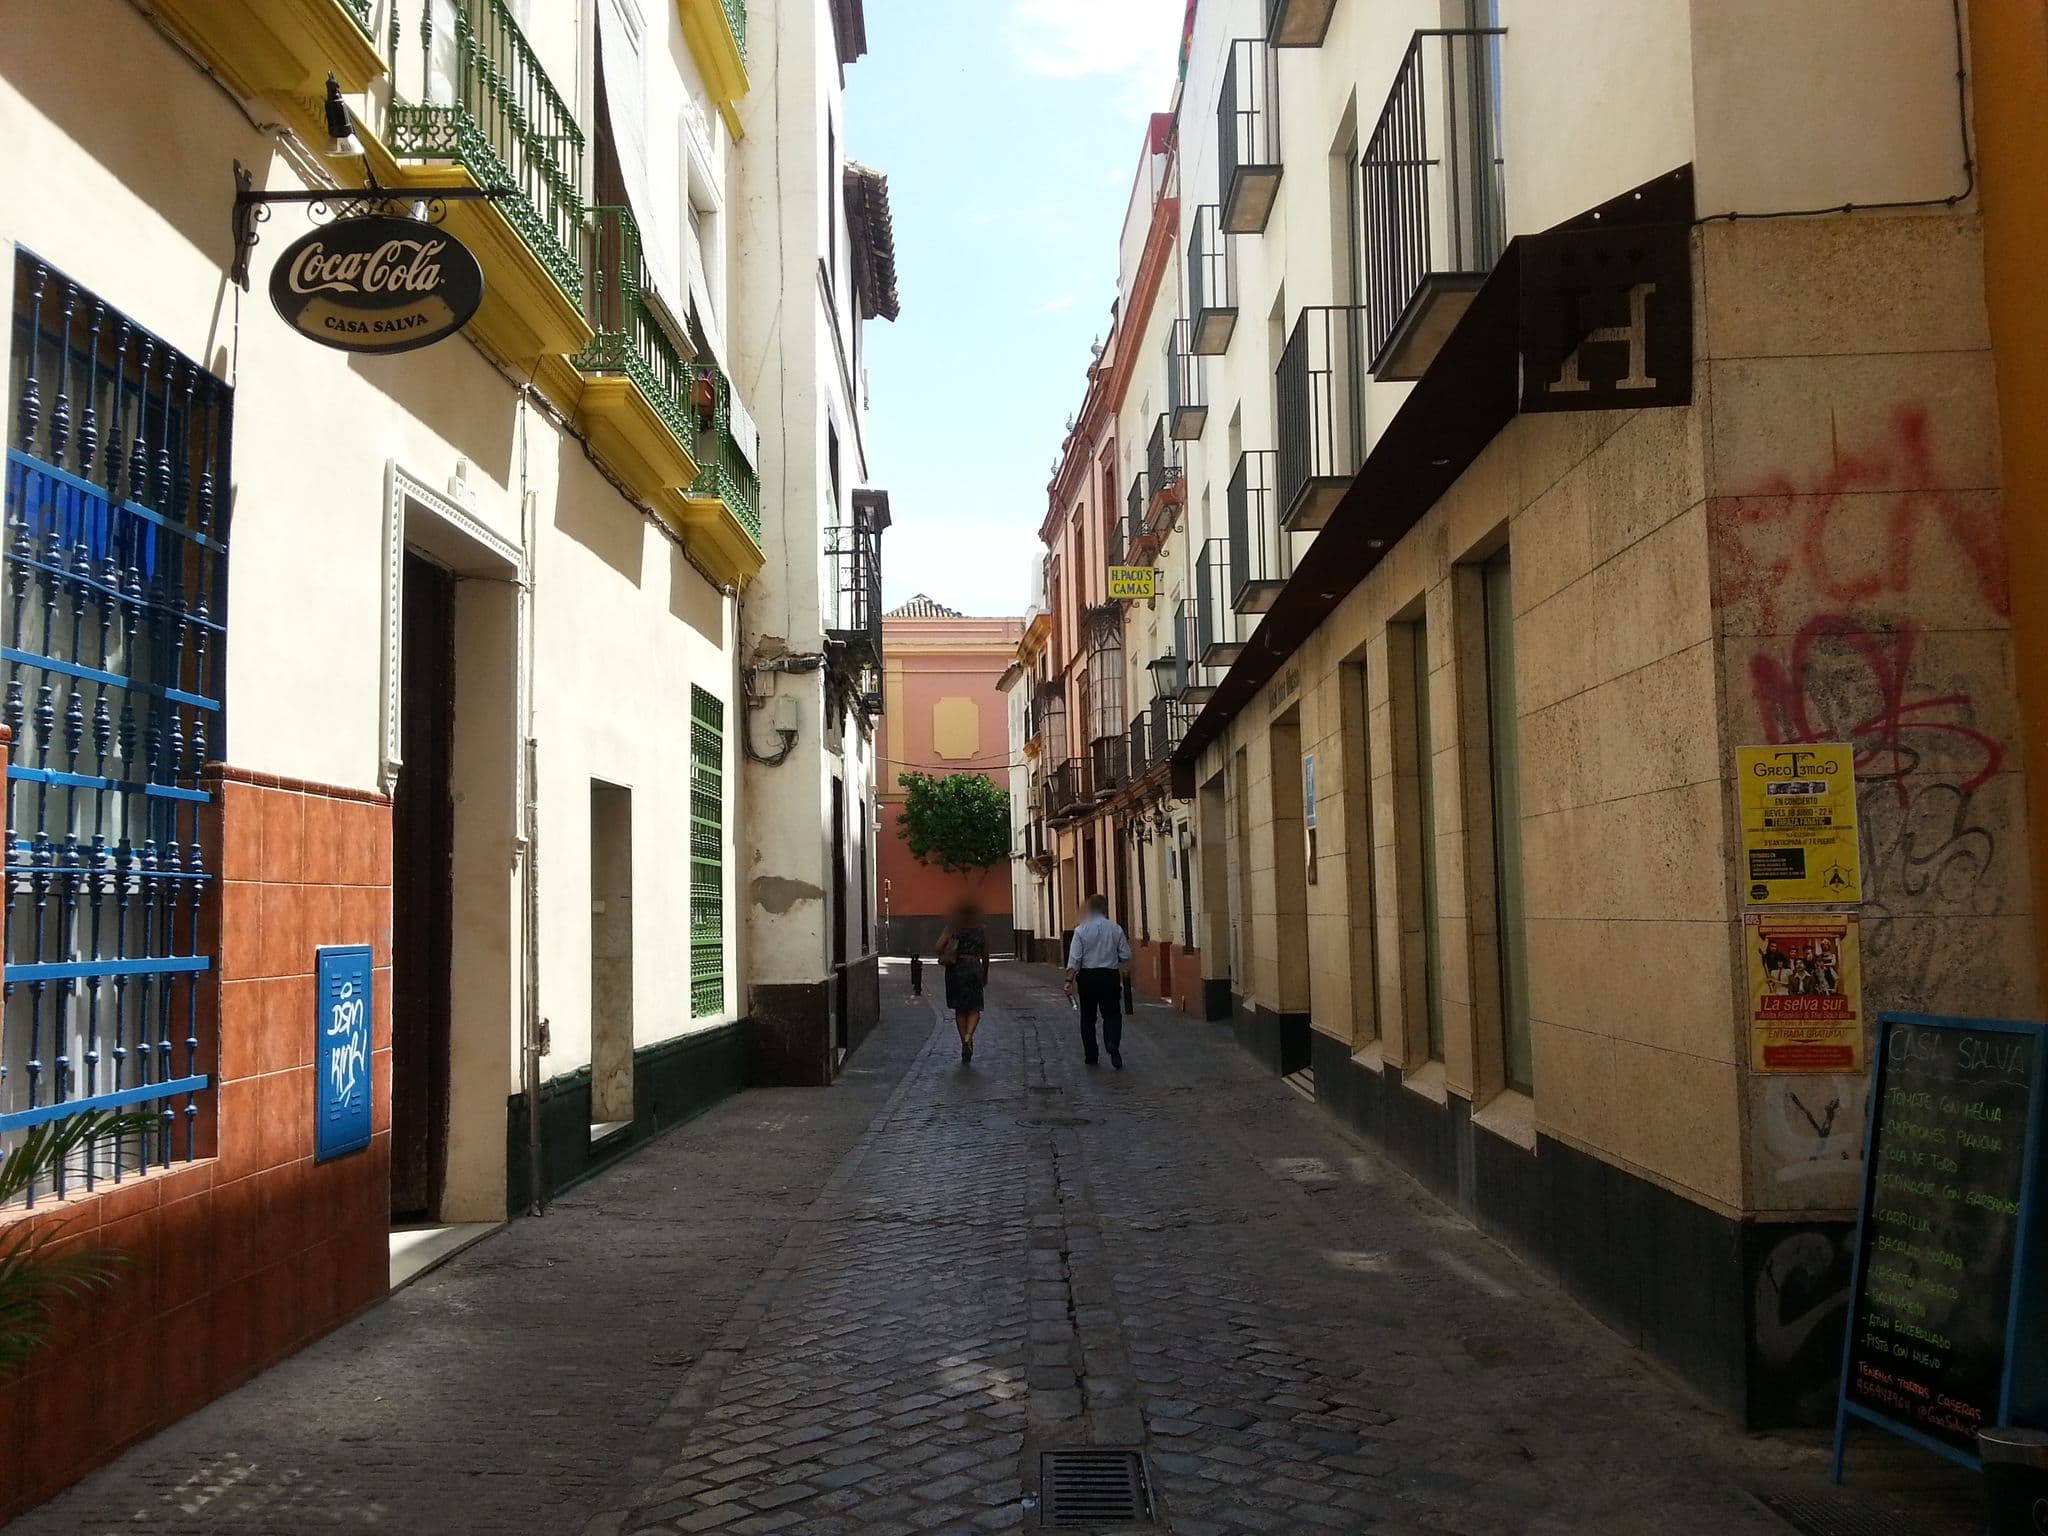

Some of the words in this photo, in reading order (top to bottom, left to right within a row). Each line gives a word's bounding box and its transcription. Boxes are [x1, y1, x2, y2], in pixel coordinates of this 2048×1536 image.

[289, 240, 446, 294] Coca-Cola
[324, 316, 370, 333] CASA
[373, 312, 429, 332] SALVA
[1113, 584, 1149, 594] CAMAS
[1774, 798, 1783, 806] EN
[1784, 797, 1818, 805] CONCIERTO
[1764, 808, 1786, 817] JUEVES
[1764, 997, 1780, 1011] La
[1783, 996, 1819, 1011] selva
[1822, 999, 1845, 1011] sur
[1768, 1029, 1803, 1039] ENTRADA
[1889, 1030, 1942, 1062] CASA
[1912, 1153, 1925, 1167] DE
